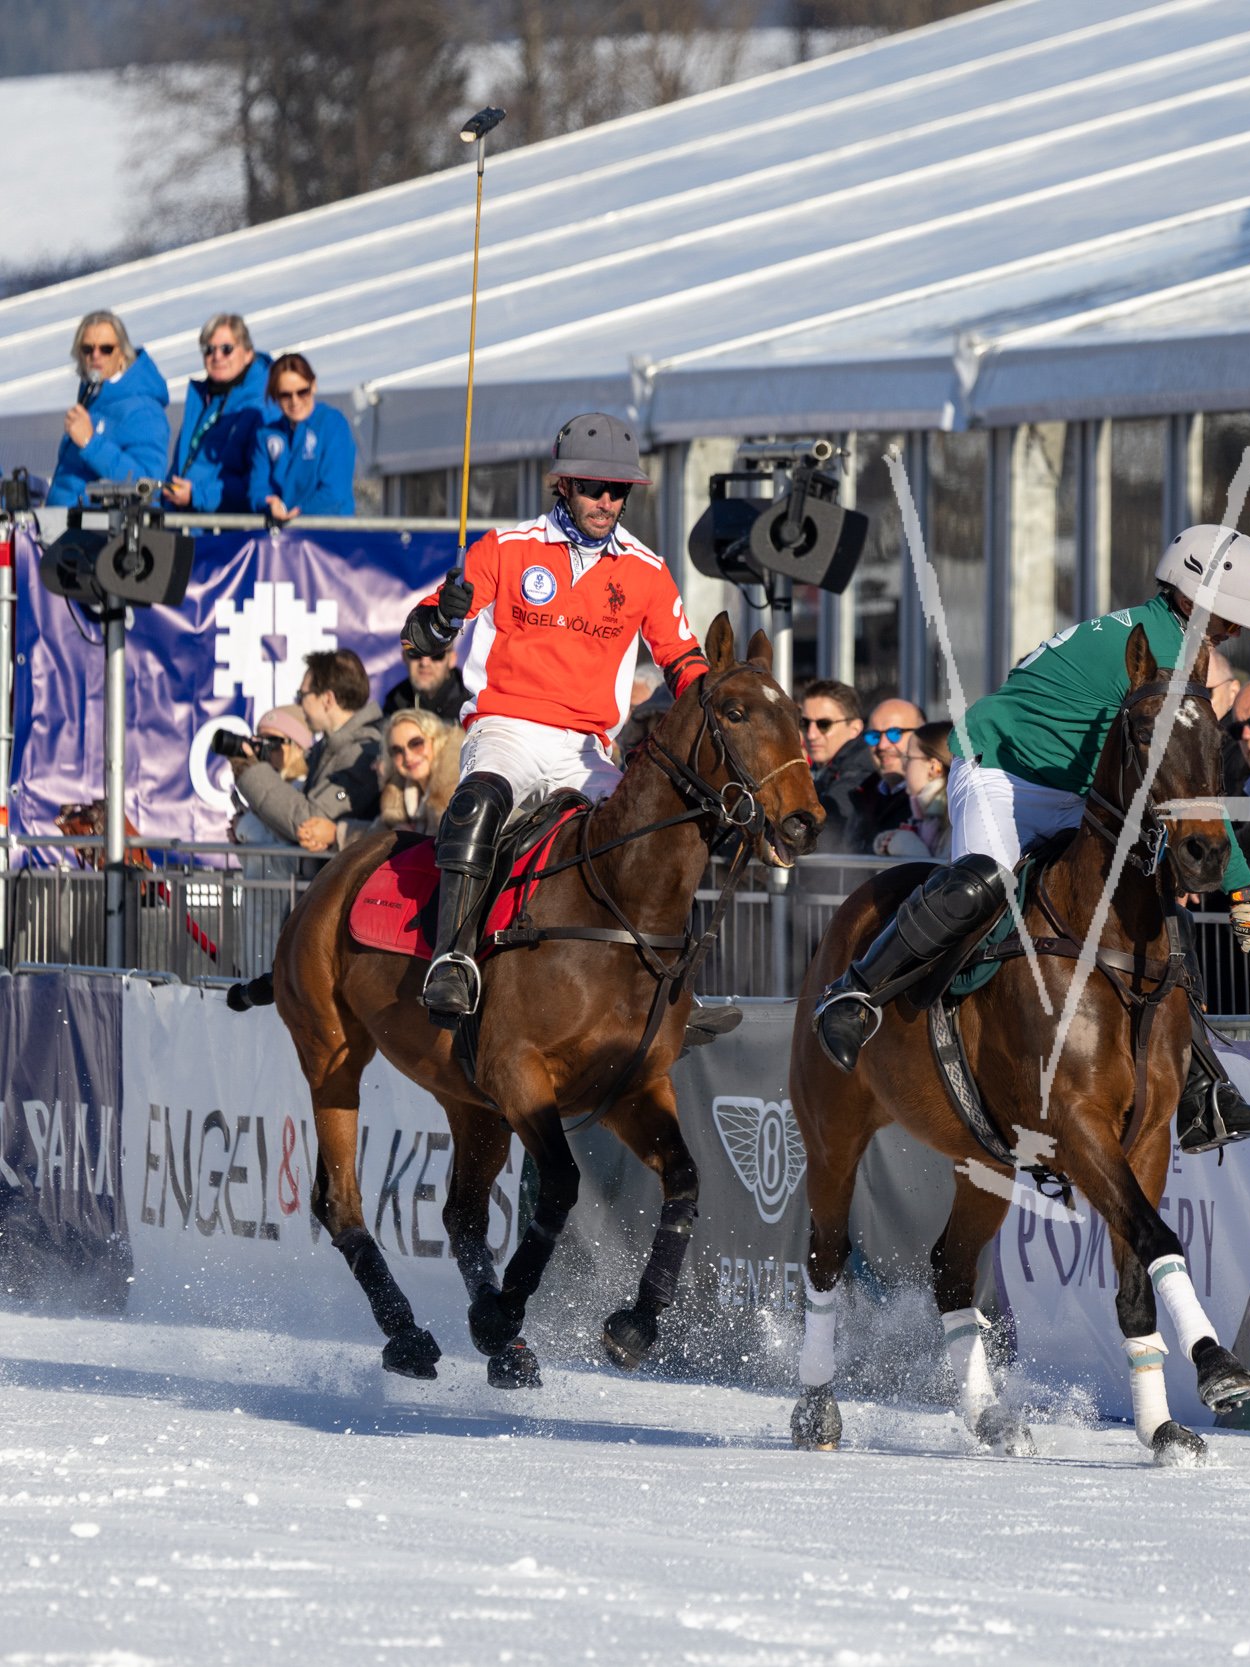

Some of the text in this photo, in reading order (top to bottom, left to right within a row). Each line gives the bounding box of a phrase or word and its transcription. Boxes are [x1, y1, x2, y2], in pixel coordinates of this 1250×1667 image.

[141, 1103, 512, 1265] ENGEL&VKES
[719, 1256, 807, 1311] BENTLE
[1018, 1190, 1215, 1297] POMRY
